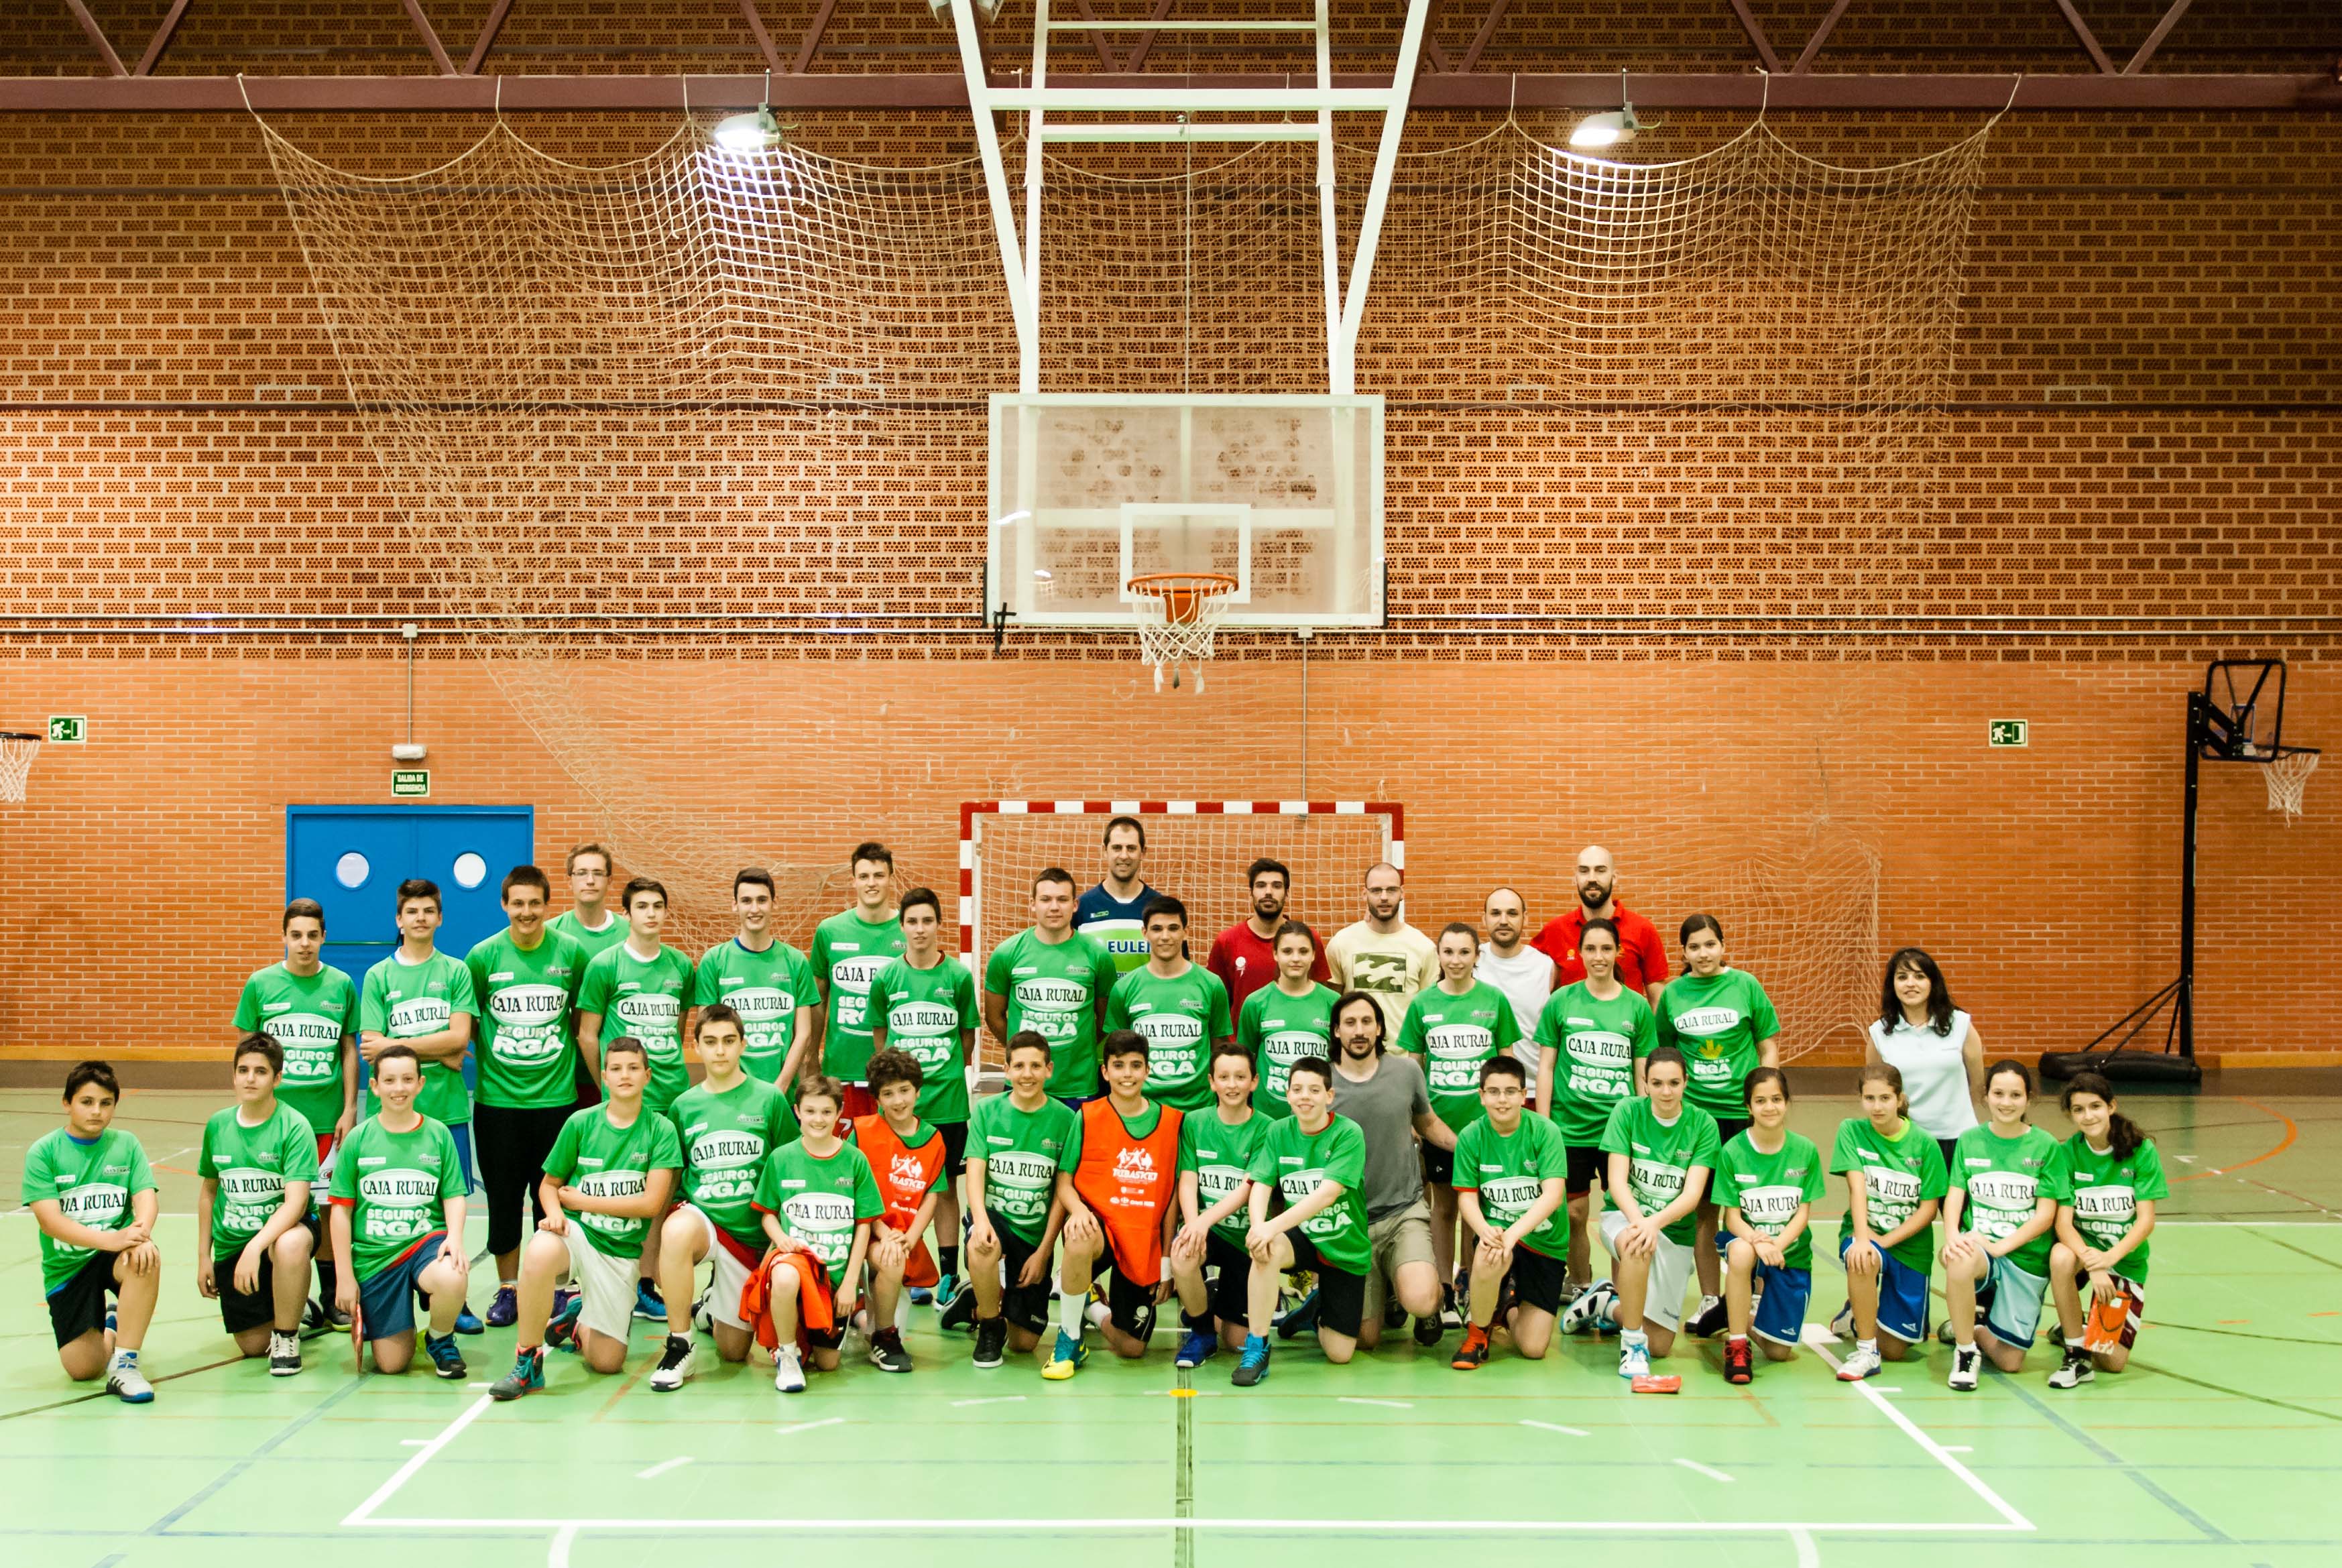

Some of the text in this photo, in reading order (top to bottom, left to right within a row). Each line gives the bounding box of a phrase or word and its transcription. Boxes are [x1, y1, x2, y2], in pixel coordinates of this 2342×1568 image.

[398, 774, 424, 782] SALIDA DE
[396, 784, 426, 792] EMERGENCIA
[835, 967, 864, 982] CAJA
[1018, 987, 1084, 1002] CAJA RURAL
[493, 994, 564, 1012] CAJA RURAL
[622, 1002, 649, 1016] CAJA
[754, 998, 790, 1010] RURAL
[892, 1012, 955, 1026] CAJA RURAL
[1022, 1010, 1078, 1022] SEGUROS
[1677, 1013, 1735, 1030] CAJA RURAL
[266, 1023, 339, 1040] CAJA RURAL
[745, 1023, 785, 1032] GUROS
[1161, 1024, 1200, 1037] RURAL
[493, 1034, 565, 1054] RGA
[745, 1032, 784, 1046] GA
[894, 1037, 951, 1048] SEGUROS
[1454, 1034, 1490, 1047] RURAL
[1267, 1040, 1292, 1054] CAJA
[1569, 1038, 1631, 1059] CAJA RURA
[284, 1050, 334, 1061] GUROS
[911, 1049, 951, 1062] GA
[1149, 1050, 1196, 1060] GUROS
[1571, 1065, 1630, 1082] SEGUROS
[1694, 1063, 1731, 1074] RGA
[1568, 1075, 1631, 1096] RGA
[719, 1140, 760, 1155] RURAL
[243, 1178, 285, 1193] RURAL
[581, 1178, 647, 1196] AJA RURA
[1198, 1172, 1220, 1189] AJA
[1653, 1171, 1684, 1189] RURA
[363, 1181, 436, 1196] CAJA RURAL
[693, 1181, 755, 1200] RGA
[1513, 1183, 1542, 1203] RURA
[2001, 1183, 2035, 1199] RUR
[84, 1193, 126, 1211] RURAL
[986, 1194, 1046, 1215] RGA
[1768, 1195, 1799, 1211] RUR
[2076, 1195, 2136, 1212] AJA RURA
[223, 1214, 264, 1230] RG
[366, 1219, 432, 1236] RGA
[1973, 1217, 2017, 1239] RG
[811, 1244, 848, 1260] GA
